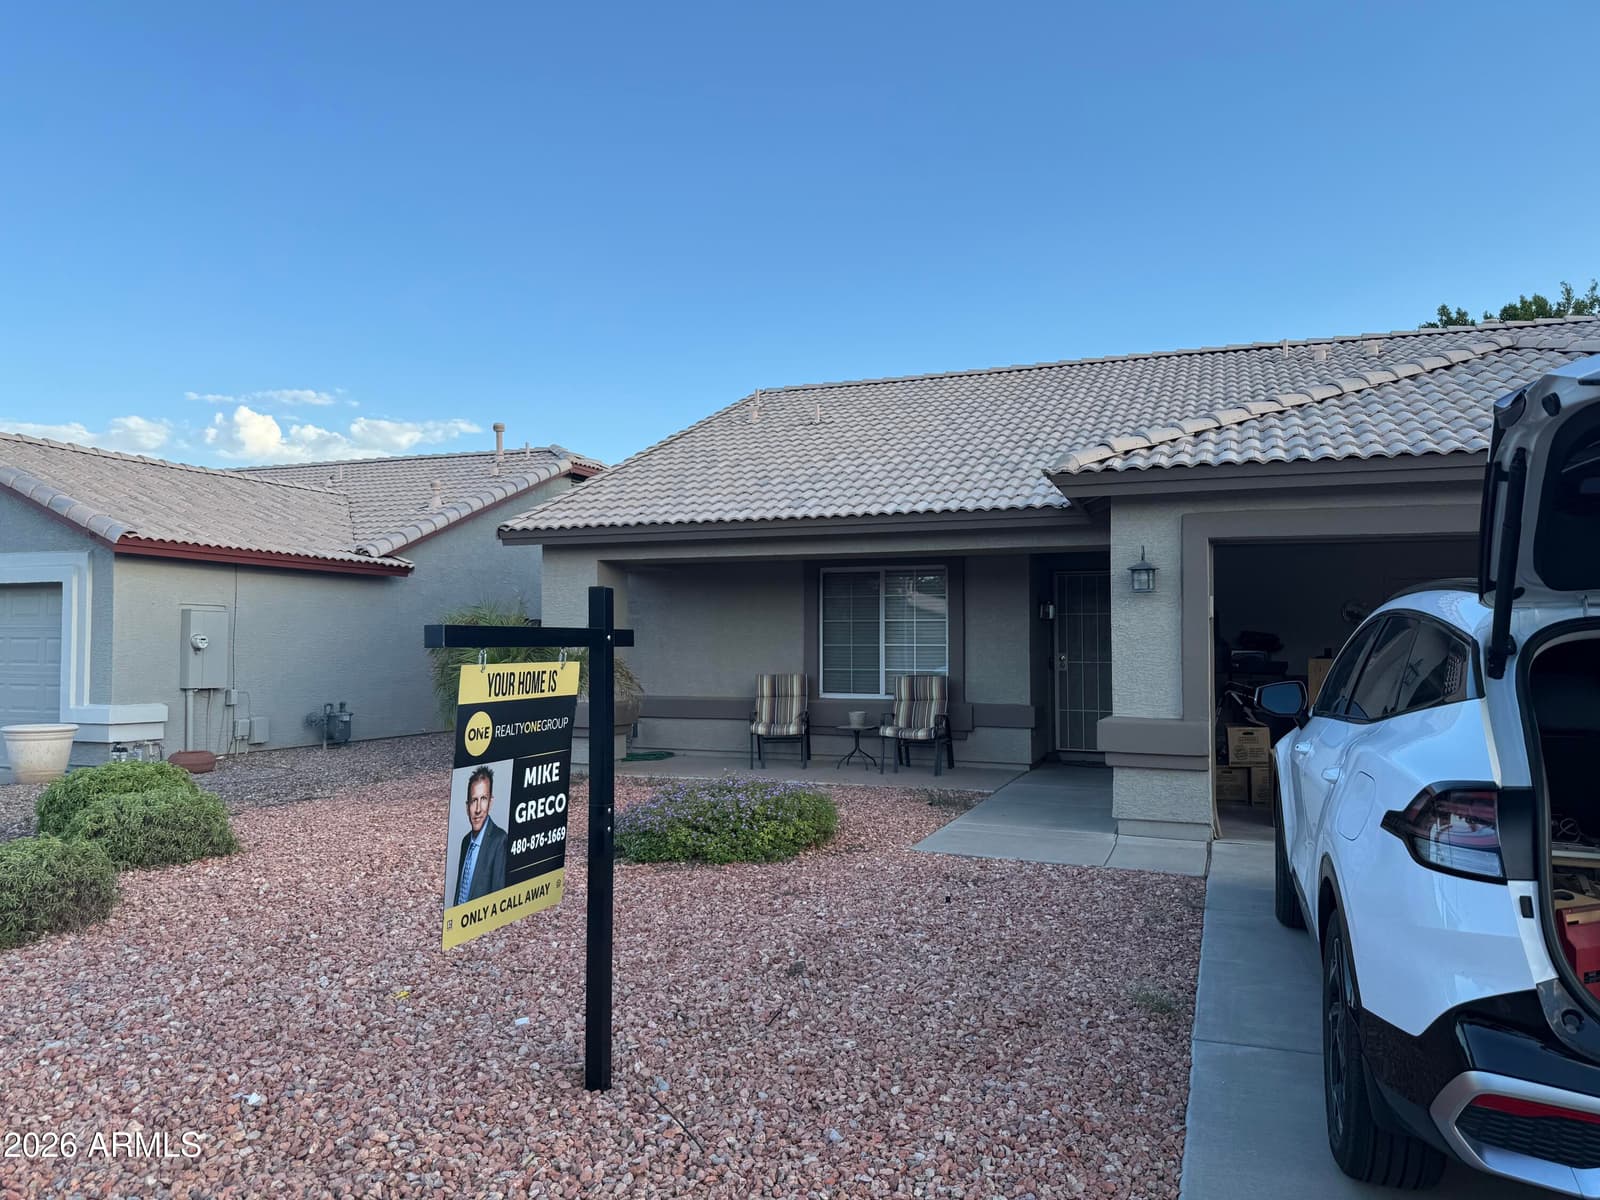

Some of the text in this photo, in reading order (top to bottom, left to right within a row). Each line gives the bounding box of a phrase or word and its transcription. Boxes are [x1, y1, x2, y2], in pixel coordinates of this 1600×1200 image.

[487, 669, 558, 698] YOUR HOME IS
[467, 726, 491, 742] ONE
[523, 761, 561, 788] MIKE
[515, 793, 567, 824] GRECO
[510, 825, 566, 856] 480-876-1669
[460, 904, 490, 929] ONLY
[490, 903, 498, 917] A
[499, 893, 524, 913] CALL
[524, 882, 551, 902] AWAY
